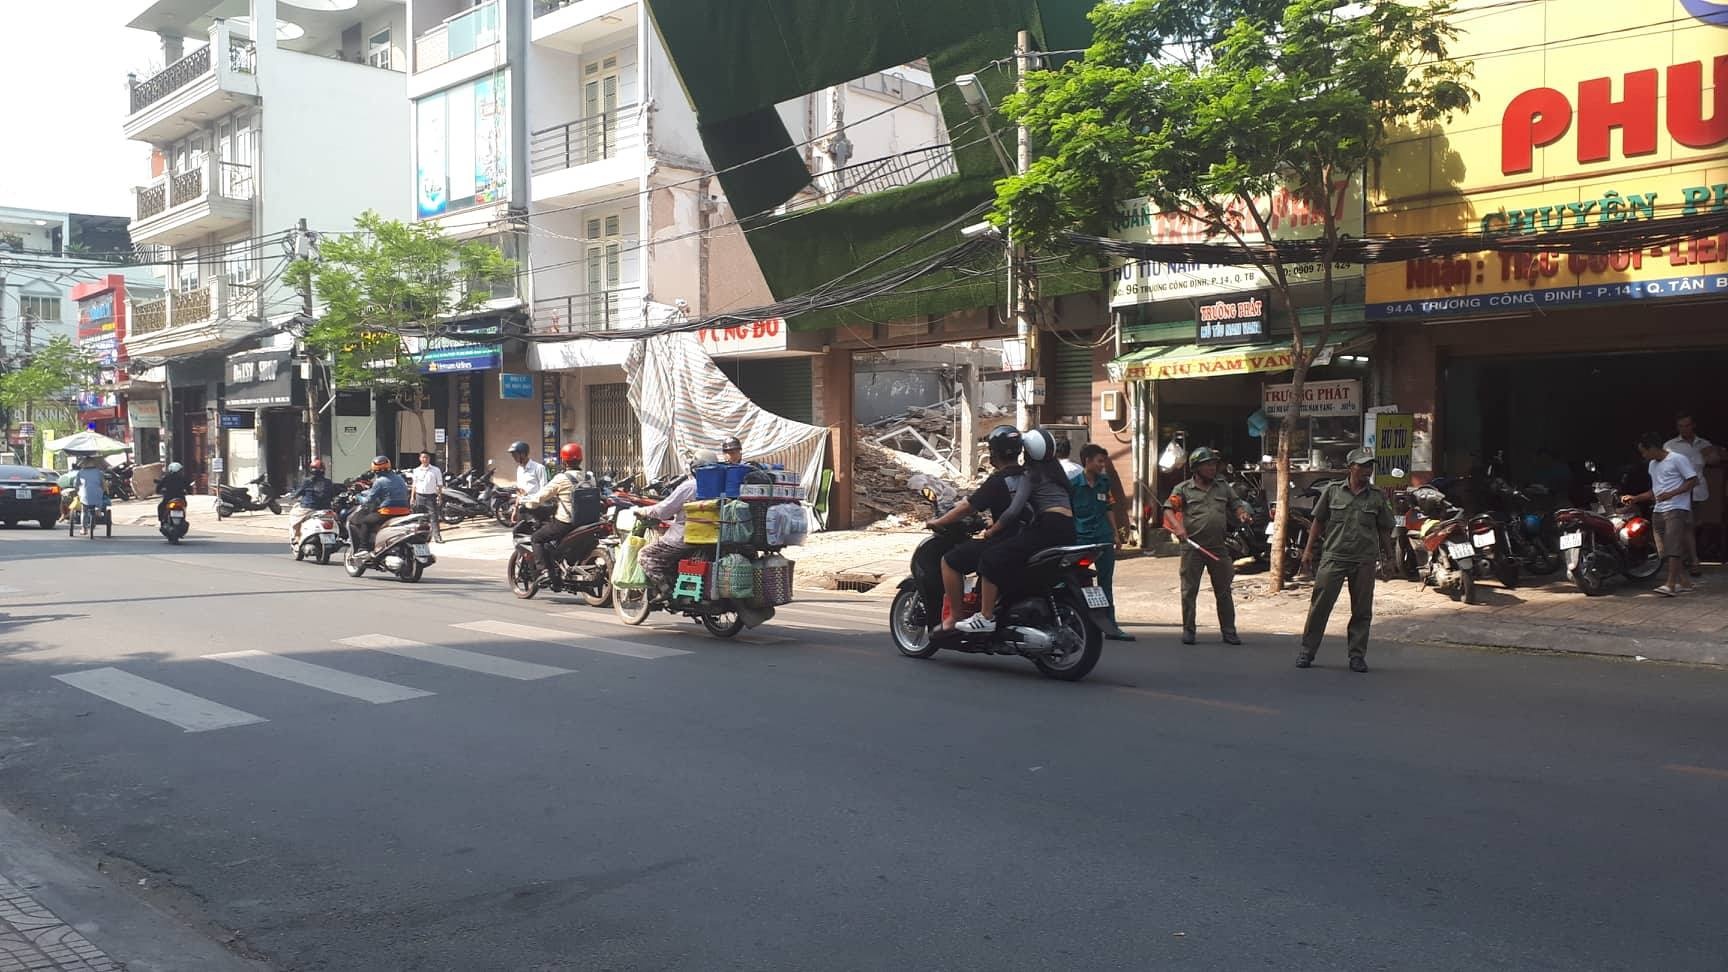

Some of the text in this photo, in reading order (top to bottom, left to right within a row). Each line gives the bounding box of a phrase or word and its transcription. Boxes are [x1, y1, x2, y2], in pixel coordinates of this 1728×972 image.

[1126, 283, 1139, 295] 96
[1489, 292, 1535, 306] CÔNG
[1668, 278, 1704, 292] TÂN
[1199, 358, 1242, 373] NAM
[1317, 384, 1350, 401] PHÁT
